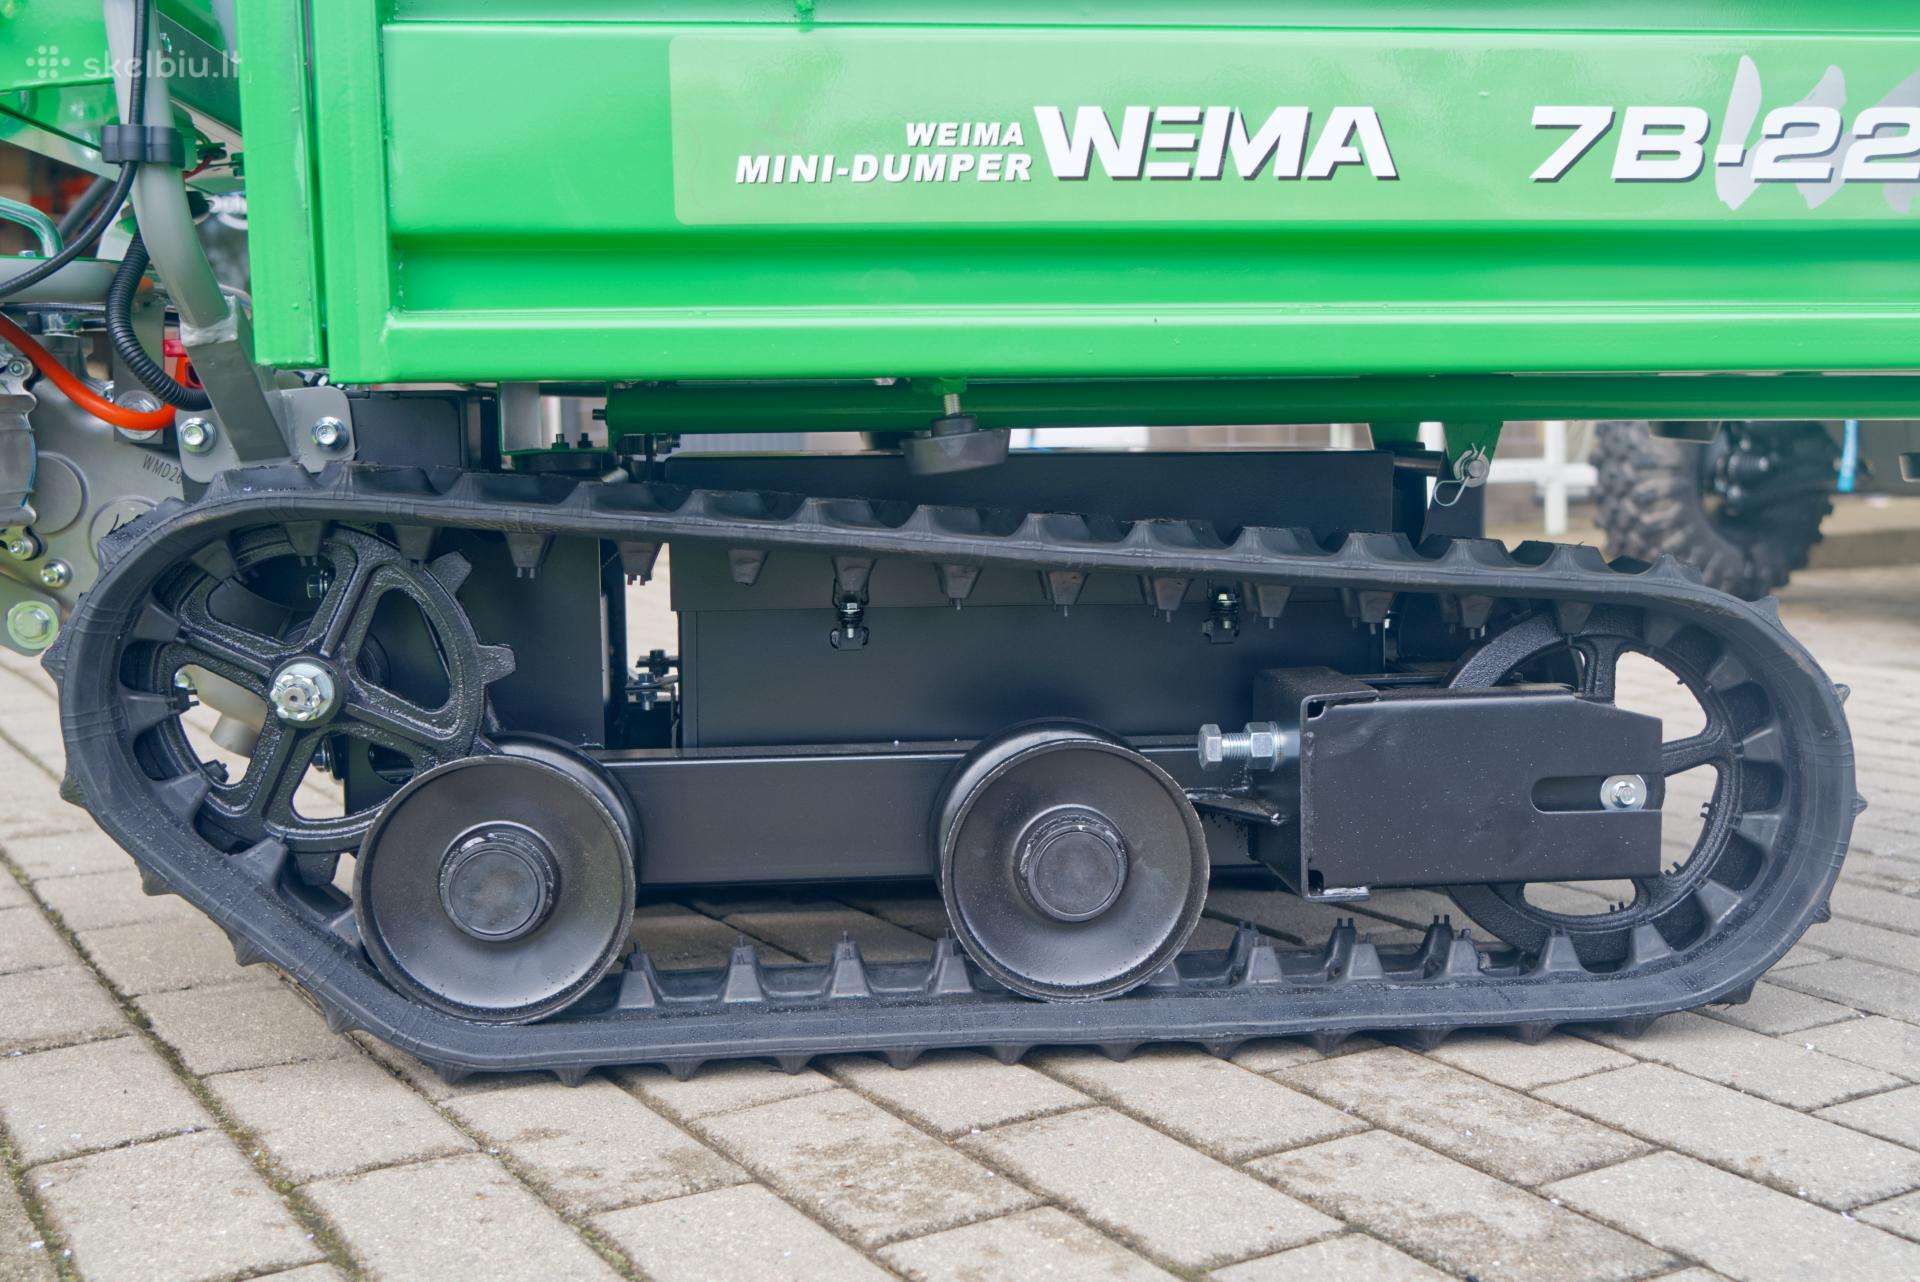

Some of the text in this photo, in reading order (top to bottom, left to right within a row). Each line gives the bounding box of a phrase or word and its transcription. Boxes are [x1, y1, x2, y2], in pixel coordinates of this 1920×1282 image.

[905, 121, 1025, 148] WEIMA
[1033, 105, 1400, 181] WEIMA
[1528, 105, 1920, 184] 7B-22
[735, 153, 1033, 185] MINI-DUMPER
